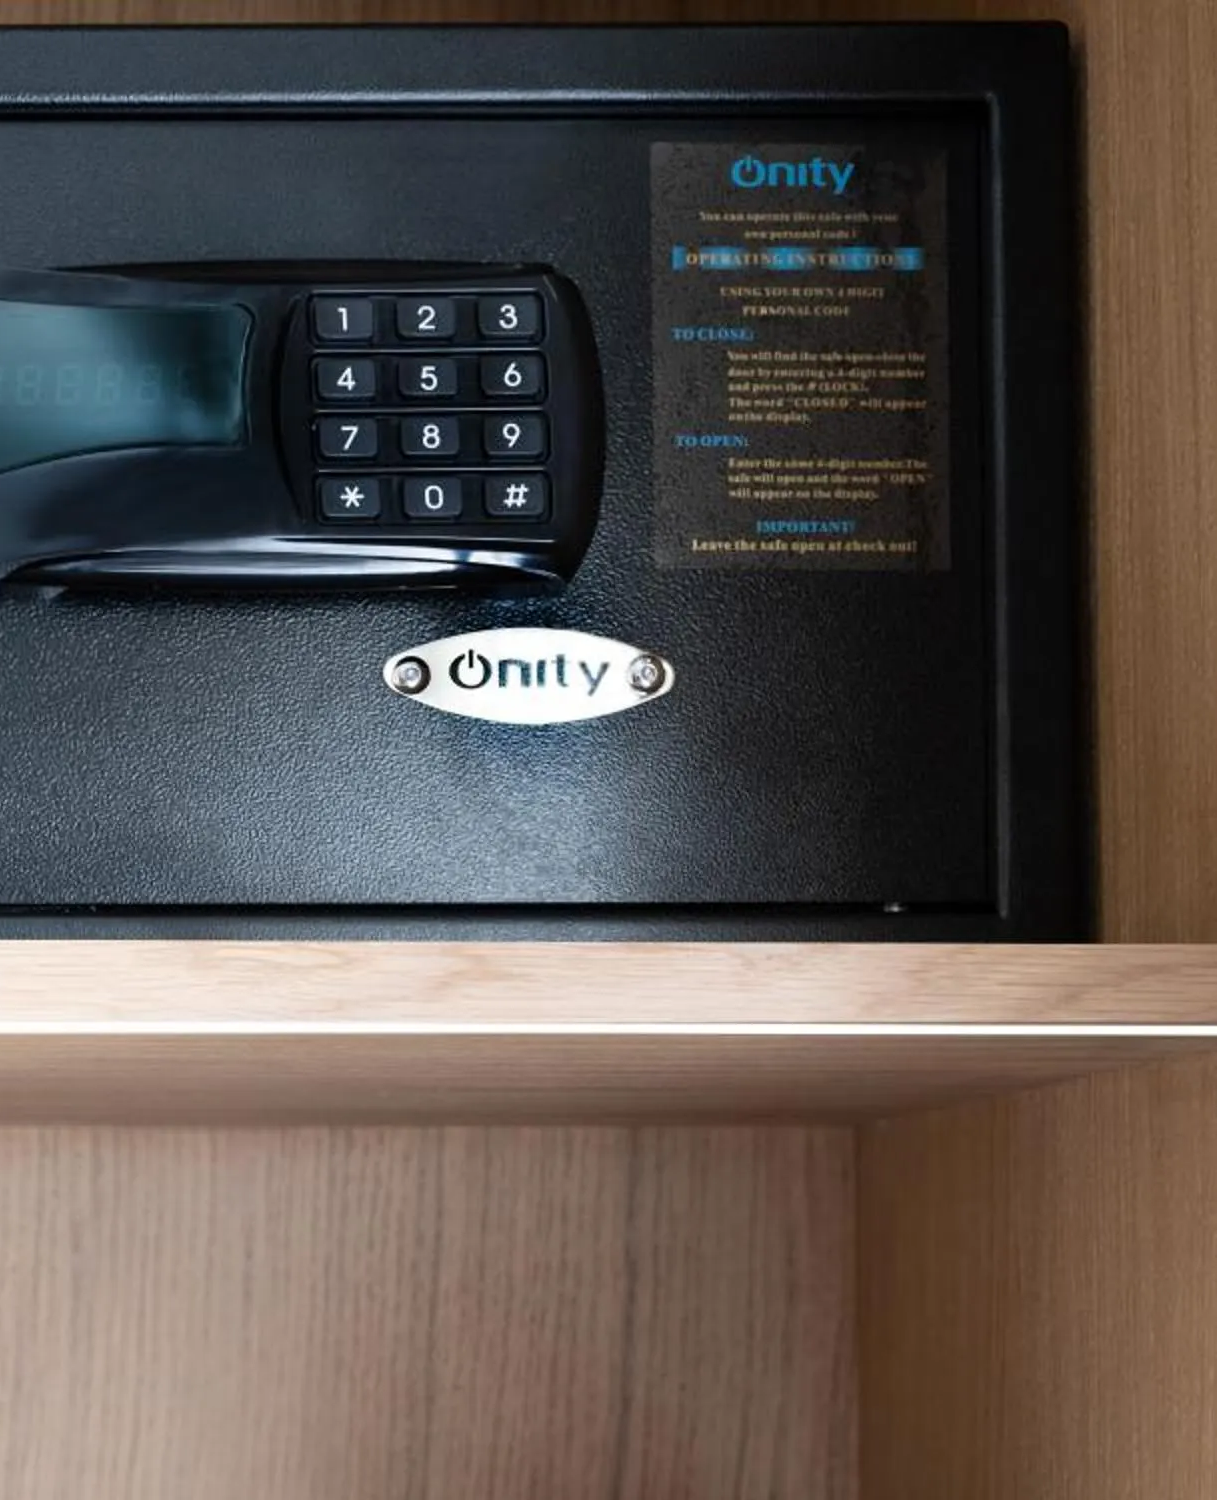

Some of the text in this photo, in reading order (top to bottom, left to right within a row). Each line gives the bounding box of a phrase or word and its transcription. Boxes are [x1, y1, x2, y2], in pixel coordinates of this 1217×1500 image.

[731, 154, 854, 194] Onity
[685, 252, 782, 266] OPERATING
[337, 304, 518, 332] 1 2 3
[672, 326, 694, 341] TO
[336, 362, 522, 391] 4 5 6
[340, 423, 521, 450] 7 8 9
[675, 434, 697, 447] TO
[503, 483, 529, 508] #
[692, 539, 732, 551] Leave
[734, 539, 756, 551] the
[760, 539, 788, 551] safe
[791, 541, 825, 554] open
[844, 539, 885, 551] check
[449, 649, 610, 696] Onity
